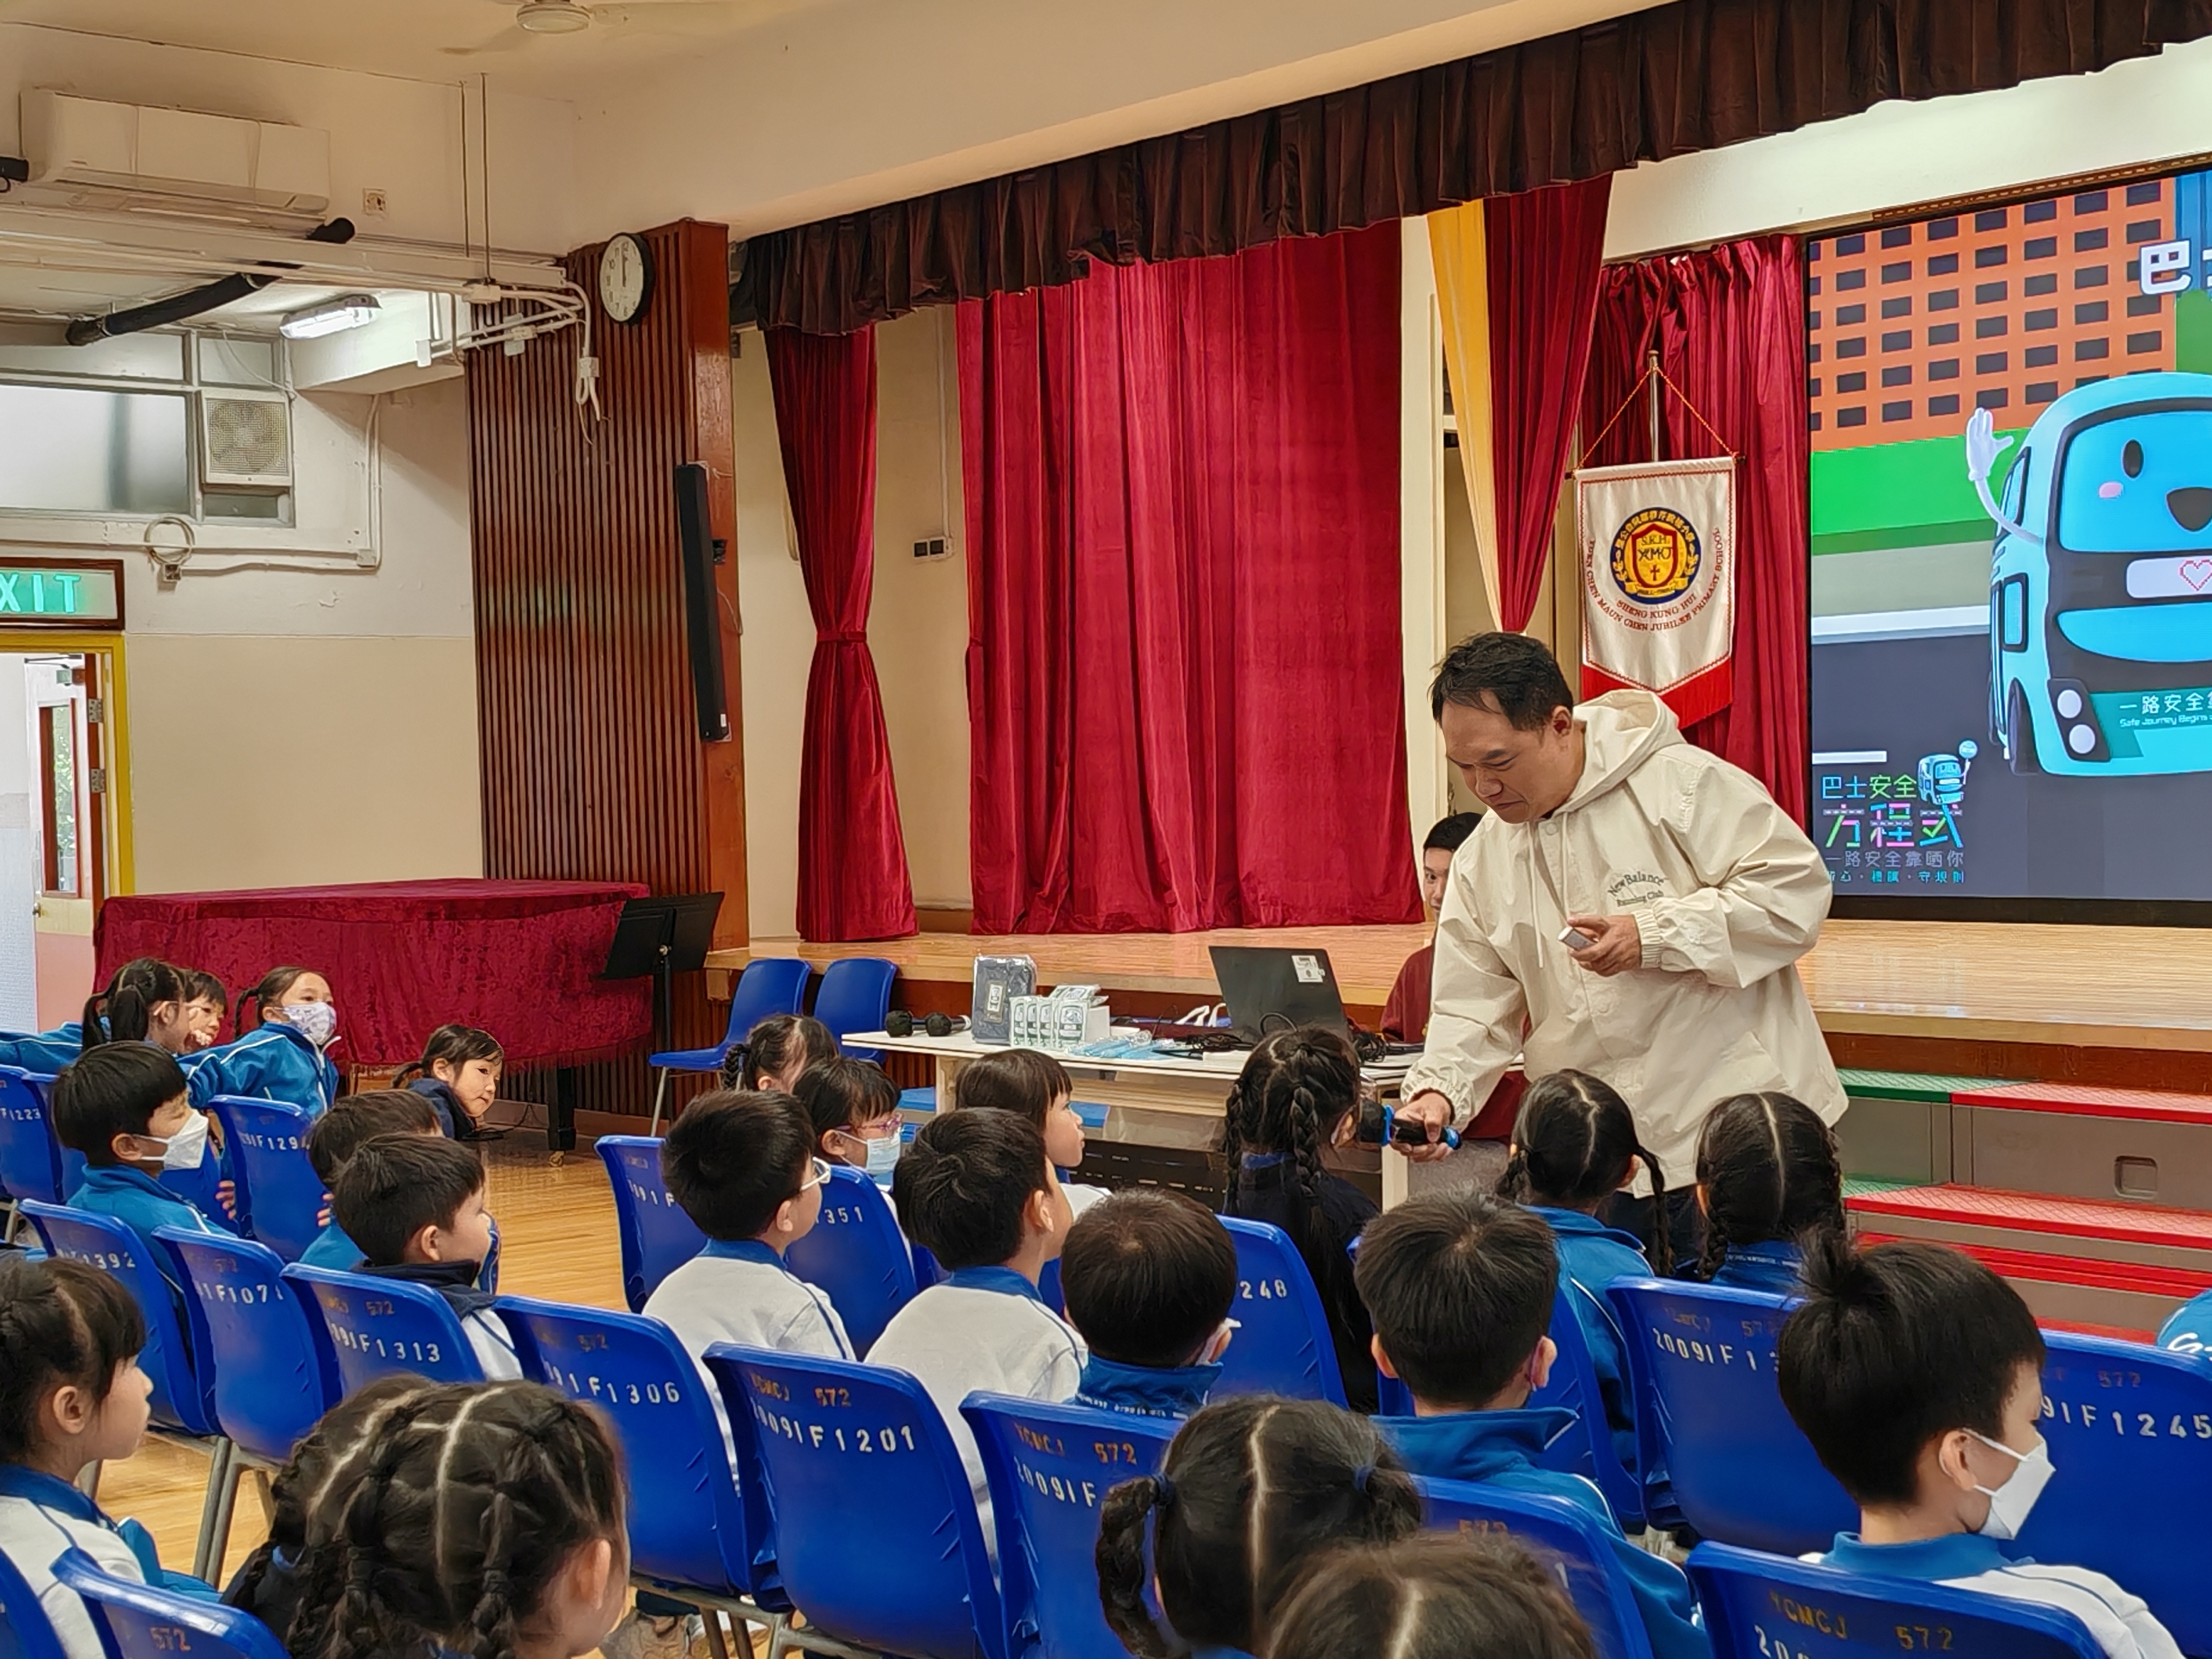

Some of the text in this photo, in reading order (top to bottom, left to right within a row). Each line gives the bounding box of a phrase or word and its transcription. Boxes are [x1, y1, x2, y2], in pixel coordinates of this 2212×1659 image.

[1650, 606, 1678, 619] KUNG
[1681, 593, 1697, 610] HUI
[2120, 718, 2140, 727] Safe
[2142, 717, 2177, 726] Journey
[1822, 774, 1917, 799] 巴士安全
[1823, 802, 1964, 848] 方程式
[1608, 871, 1664, 896] New Balance
[814, 1387, 852, 1407] 572
[1094, 1442, 1137, 1464] 572
[1896, 1625, 1953, 1650] 572
